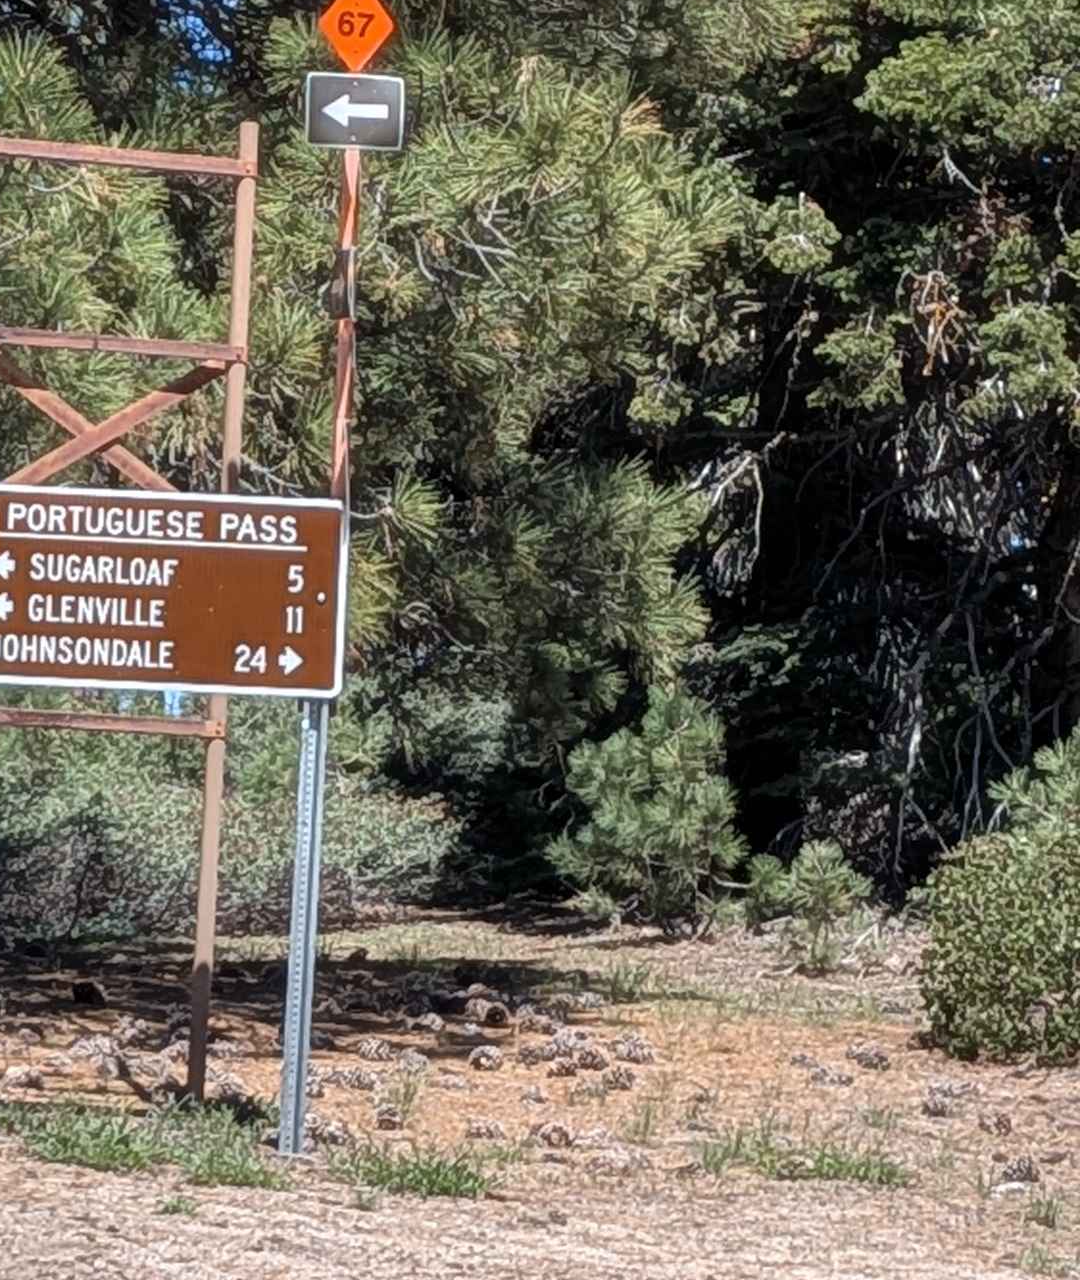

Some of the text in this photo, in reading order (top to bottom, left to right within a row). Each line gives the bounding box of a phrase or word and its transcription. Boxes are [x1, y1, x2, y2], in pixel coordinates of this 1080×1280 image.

[337, 10, 375, 38] 67
[7, 502, 298, 544] PORTUGUESE PASS
[29, 552, 304, 593] SUGARLOAF 5
[28, 593, 304, 634] GLENVILLE 11
[233, 644, 267, 674] 24
